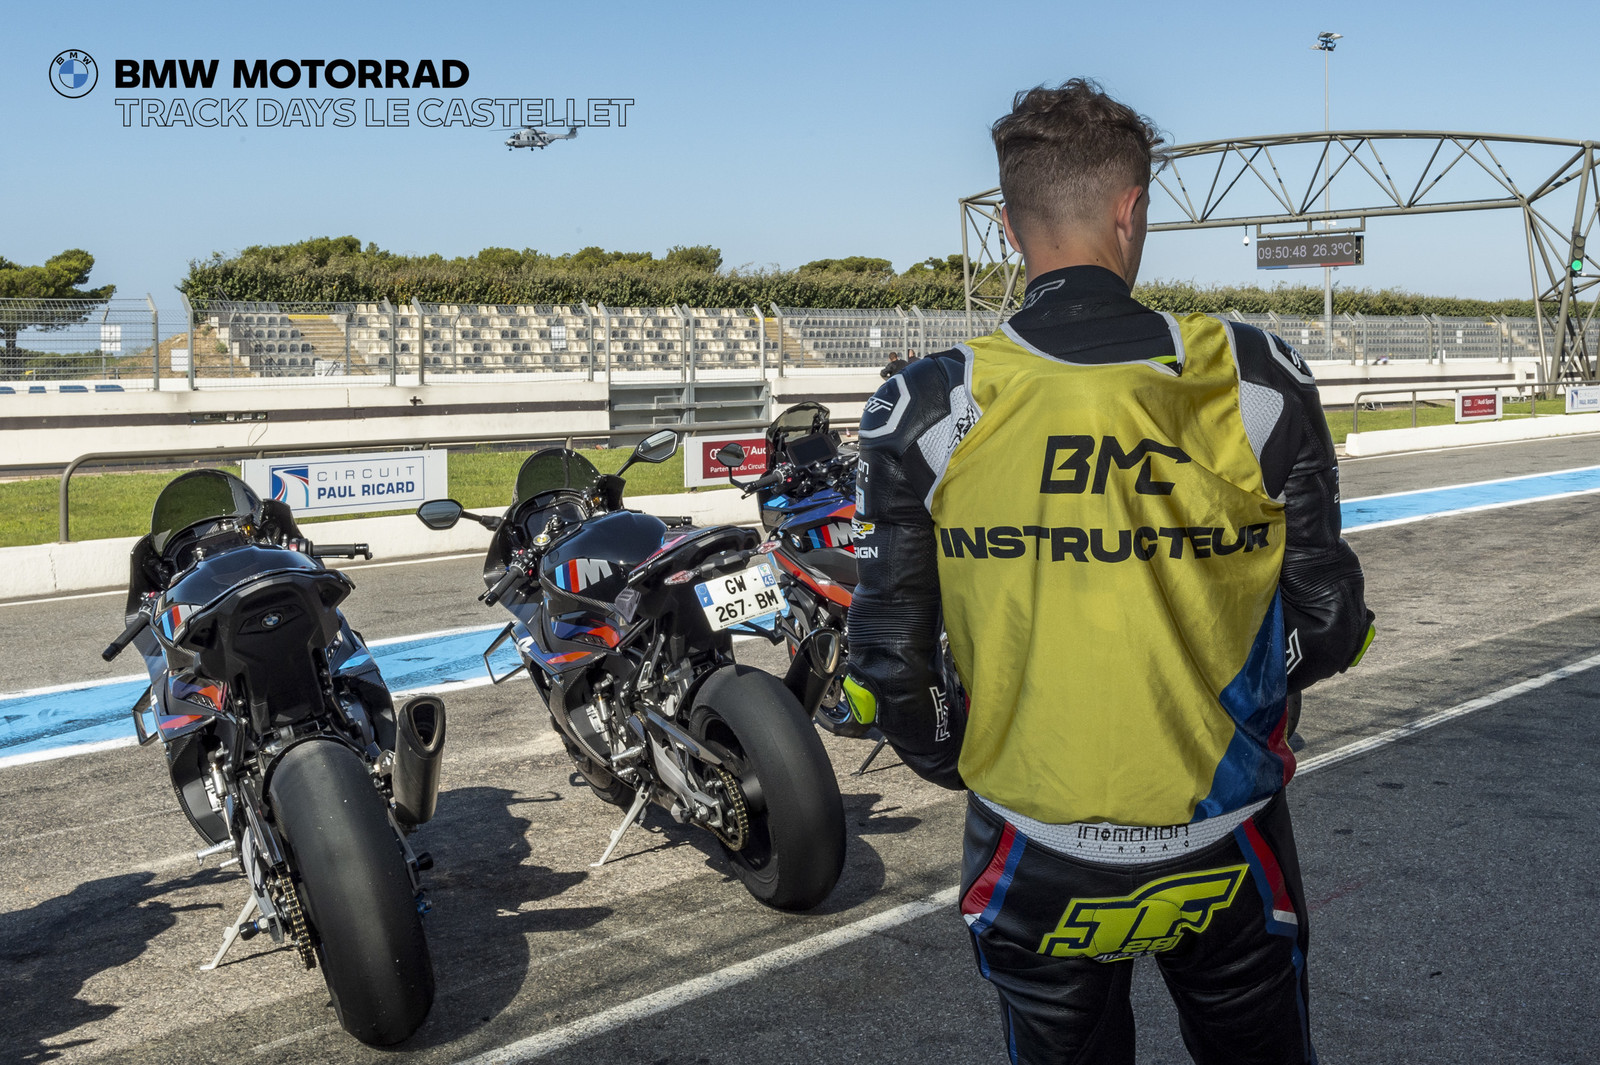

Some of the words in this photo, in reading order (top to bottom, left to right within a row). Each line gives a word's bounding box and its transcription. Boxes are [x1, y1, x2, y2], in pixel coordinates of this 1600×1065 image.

[1257, 245, 1307, 260] 09:50:48
[1039, 434, 1192, 496] BMC
[317, 466, 415, 482] CIRCUIT
[317, 485, 356, 500] PAUL
[361, 481, 415, 497] RICARD
[940, 523, 1271, 563] INSTRUCTEUR
[763, 575, 775, 585] 45
